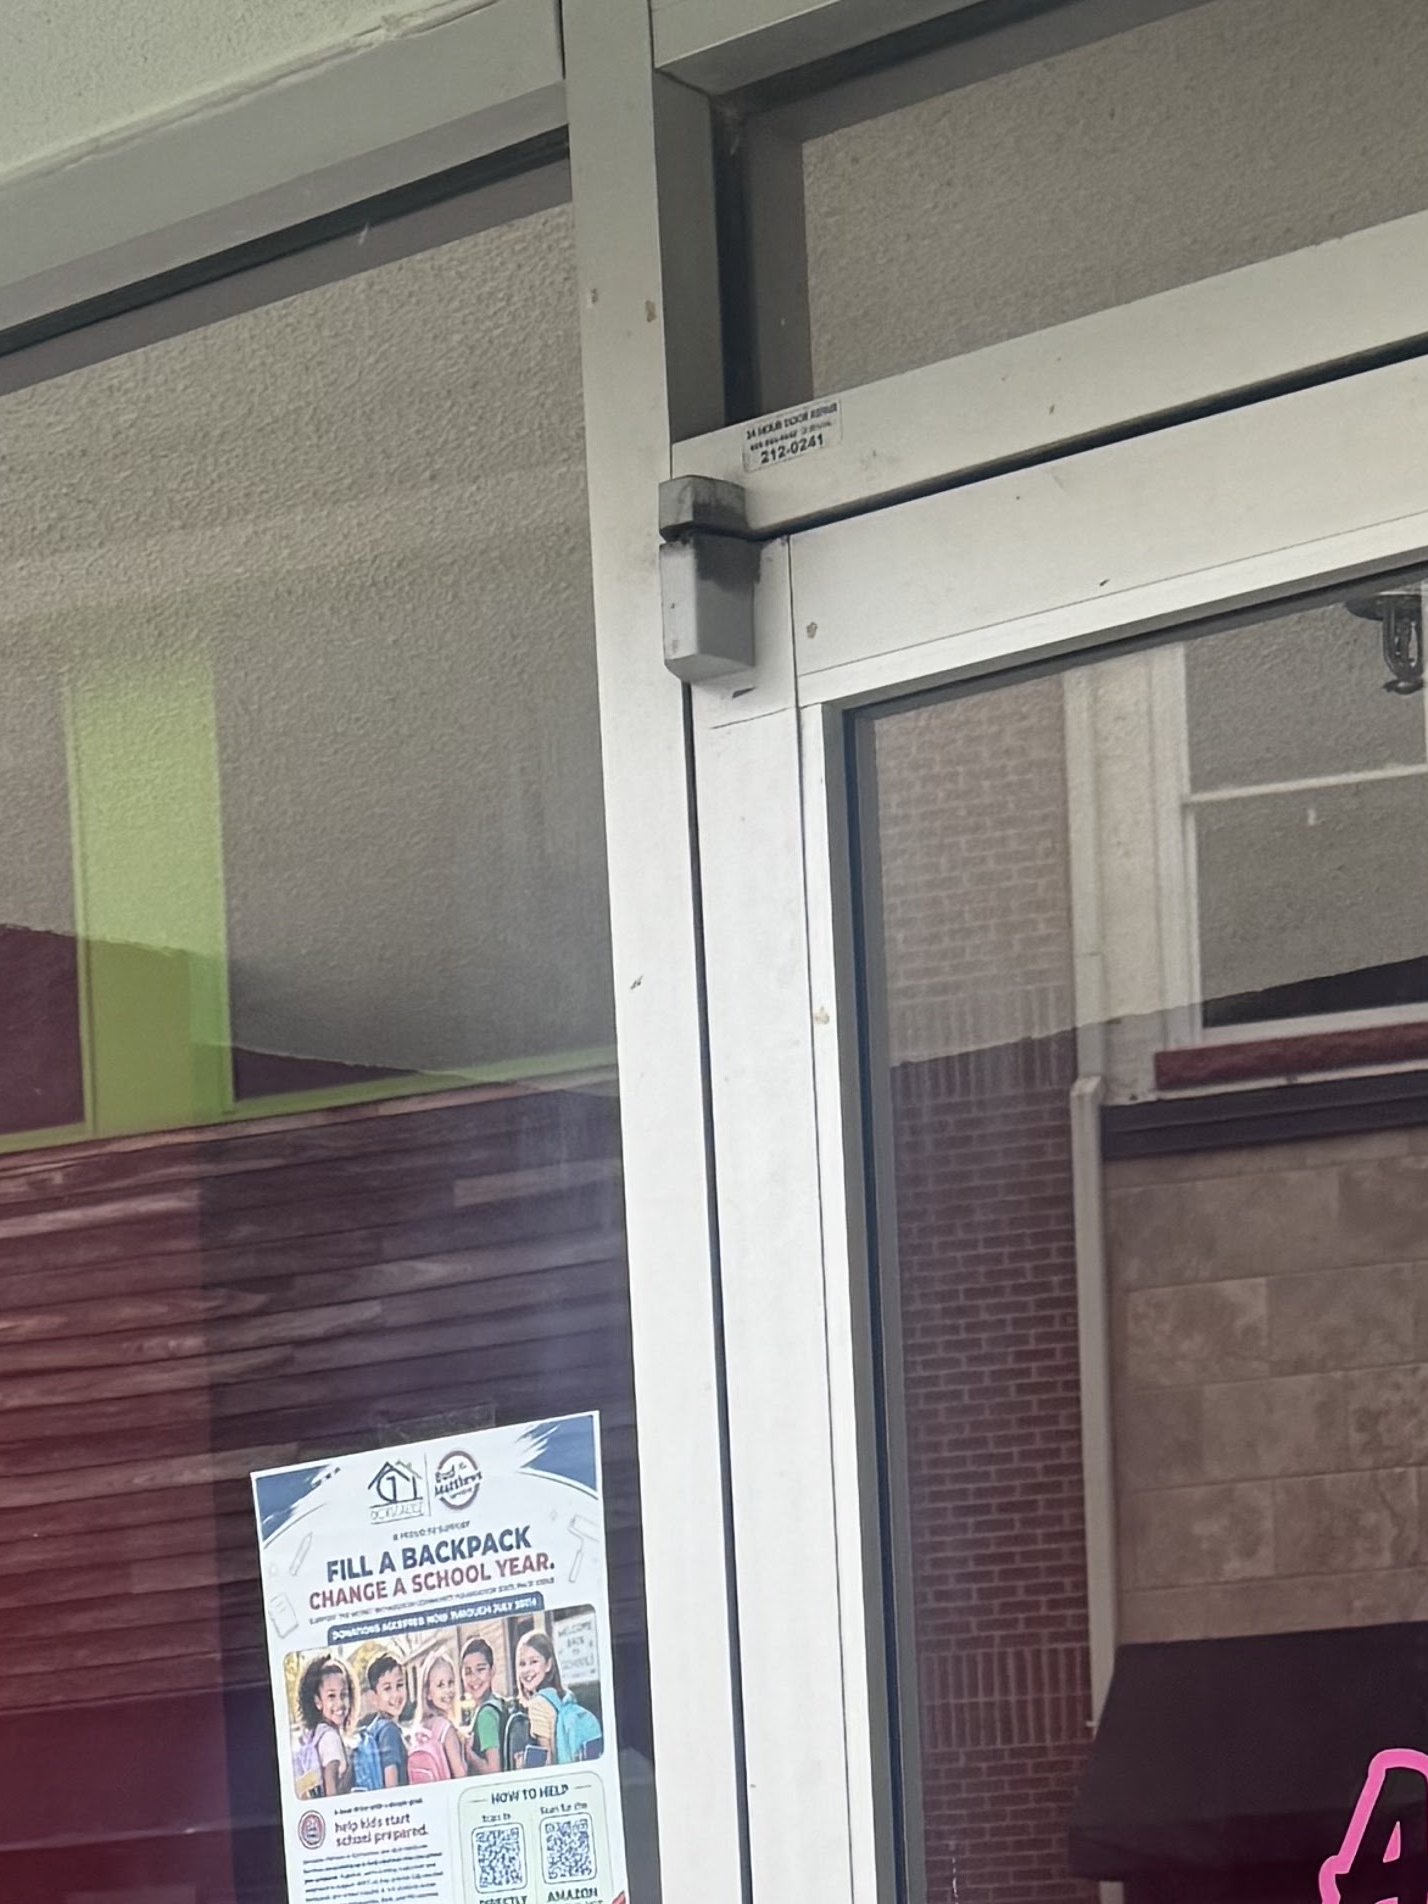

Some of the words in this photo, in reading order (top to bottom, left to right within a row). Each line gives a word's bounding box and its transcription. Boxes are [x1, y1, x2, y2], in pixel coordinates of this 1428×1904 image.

[761, 433, 823, 464] 212-0241
[326, 1556, 374, 1583] FILL
[379, 1550, 398, 1575] A
[402, 1525, 532, 1568] BACKPACK
[309, 1577, 388, 1611] CHANGE
[392, 1574, 408, 1597] A
[412, 1563, 492, 1593] SCHOOL
[496, 1552, 556, 1575] YEAR.
[491, 1792, 521, 1805] HOW
[523, 1788, 537, 1800] TO
[539, 1783, 569, 1799] HELP
[360, 1816, 383, 1830] kids
[547, 1888, 598, 1904] AMAZON
